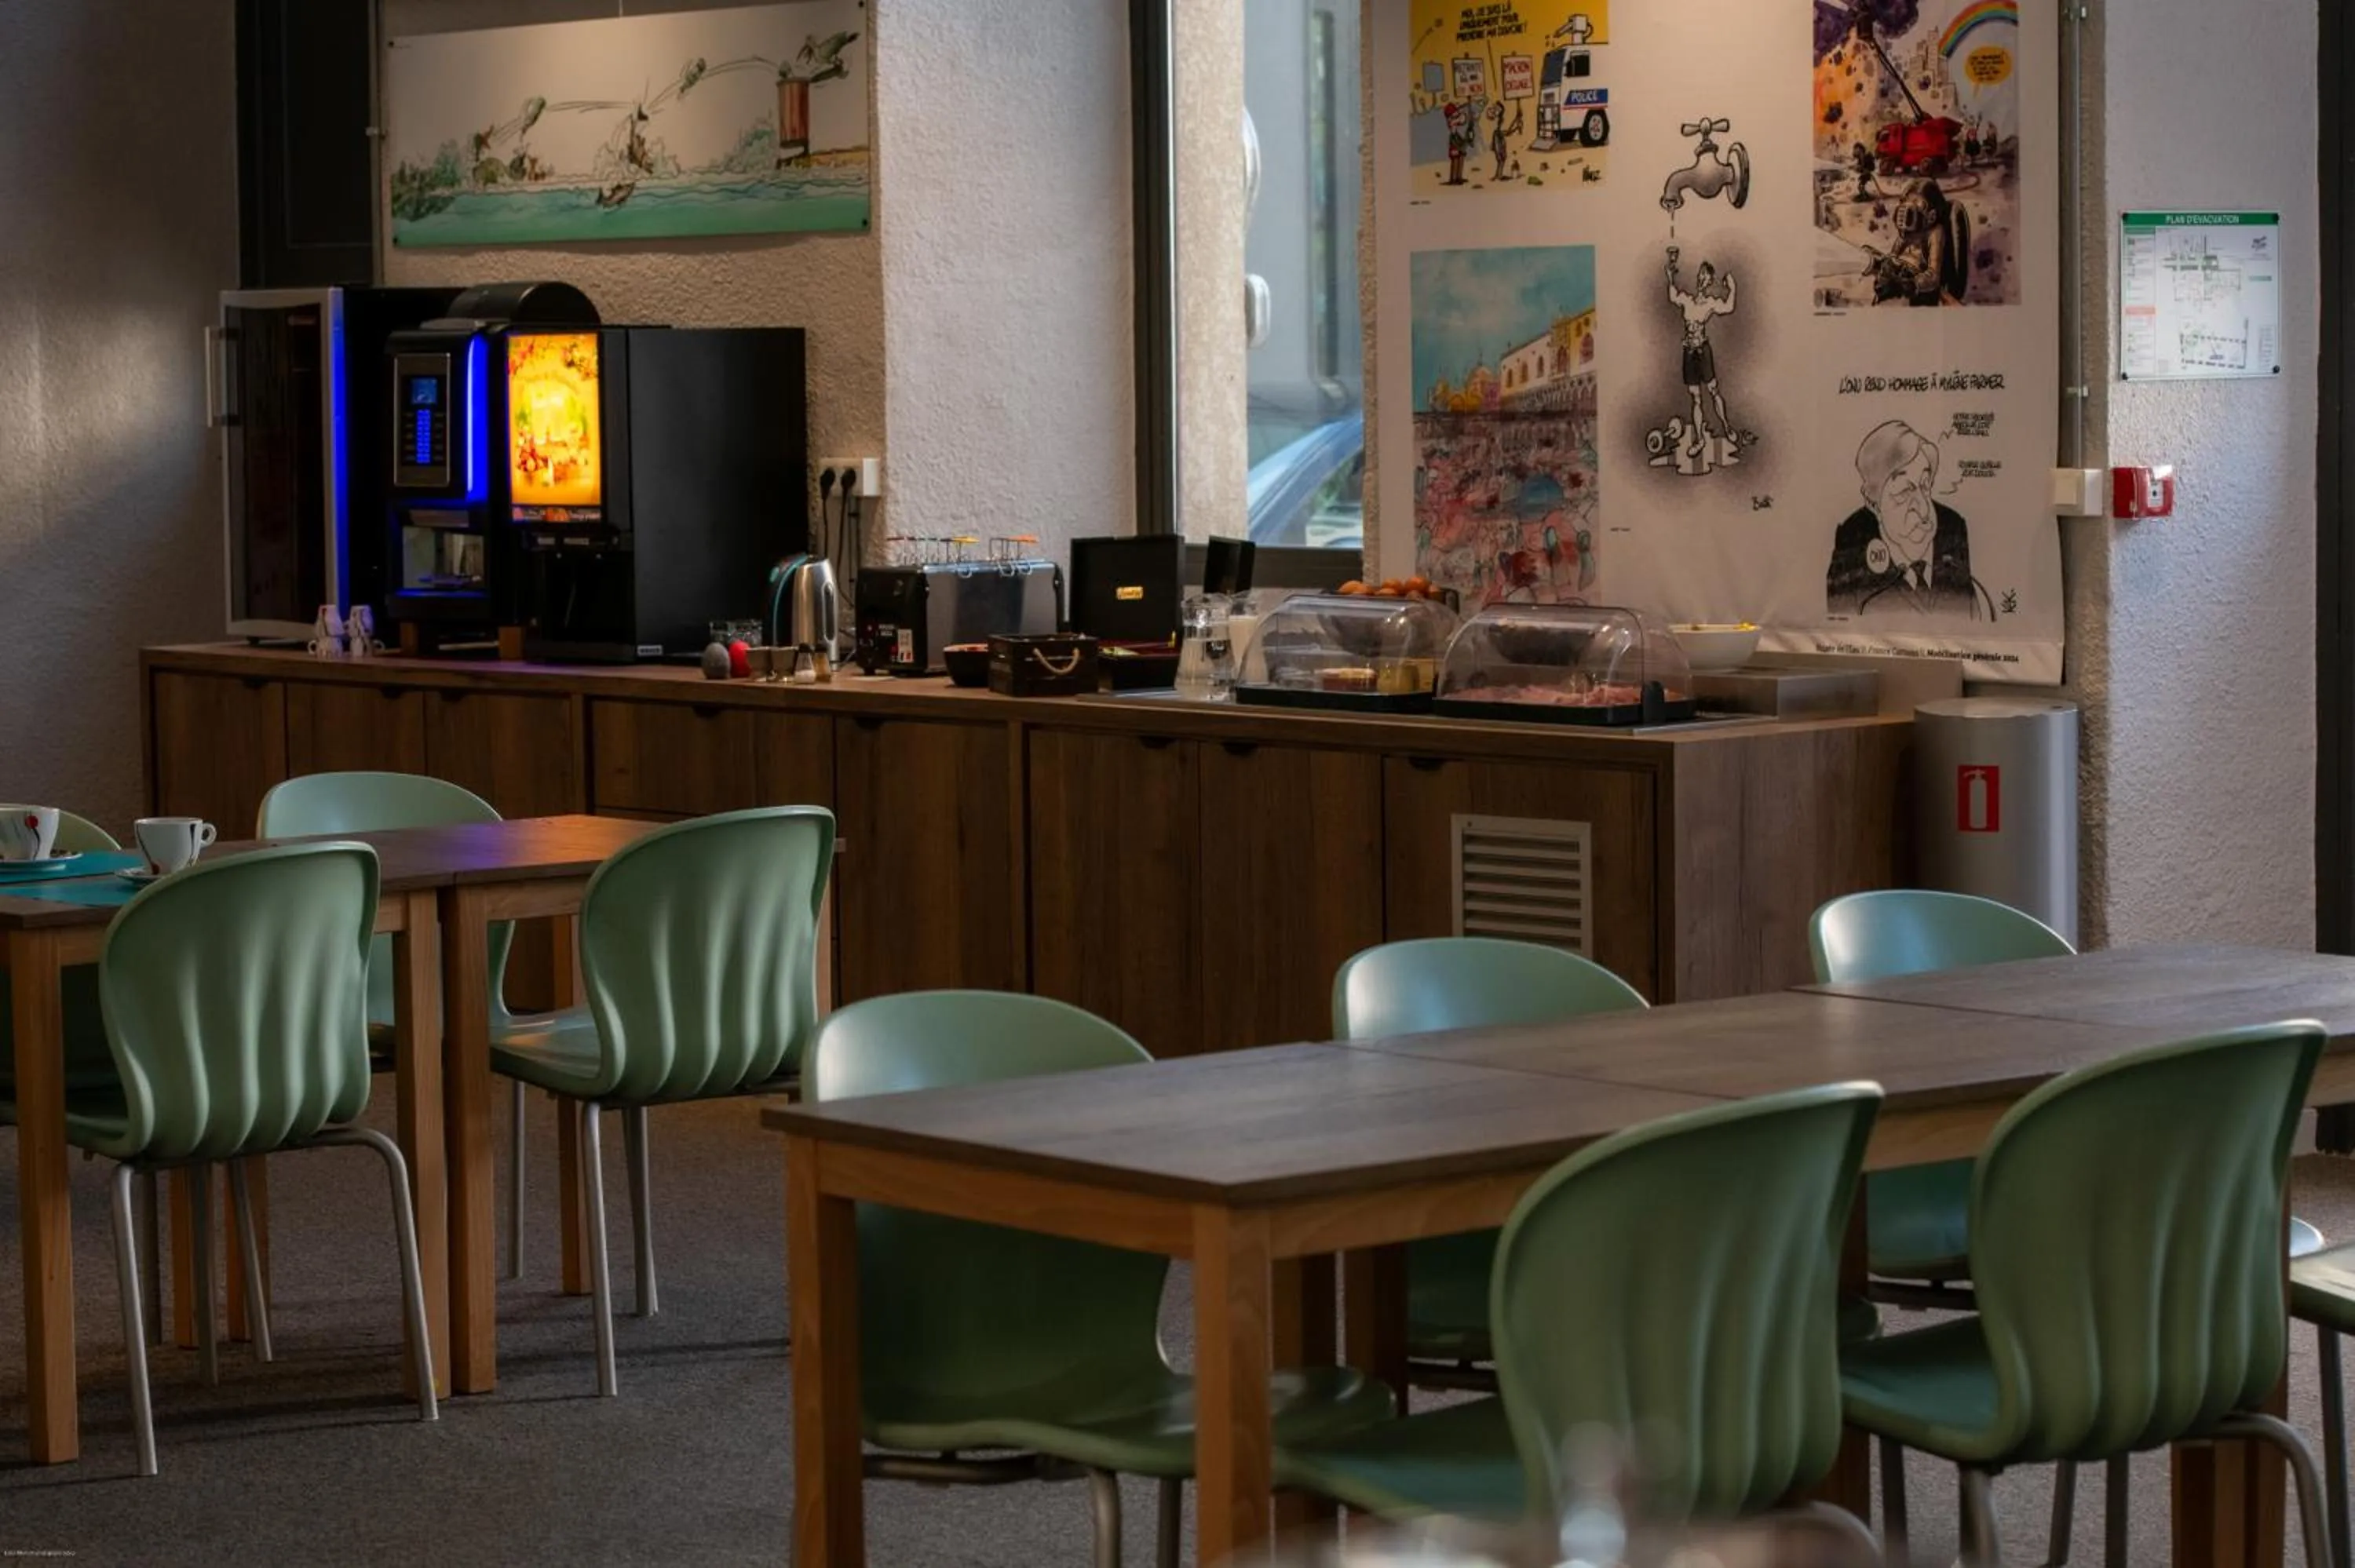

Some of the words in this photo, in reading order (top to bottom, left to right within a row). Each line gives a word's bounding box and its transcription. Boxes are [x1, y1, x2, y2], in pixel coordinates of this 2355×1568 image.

[1571, 90, 1598, 103] POLICE
[2165, 214, 2185, 224] PLAN
[1838, 375, 1862, 394] L'ONU
[1864, 376, 1886, 392] REND
[1888, 375, 1929, 392] HOMMAGE
